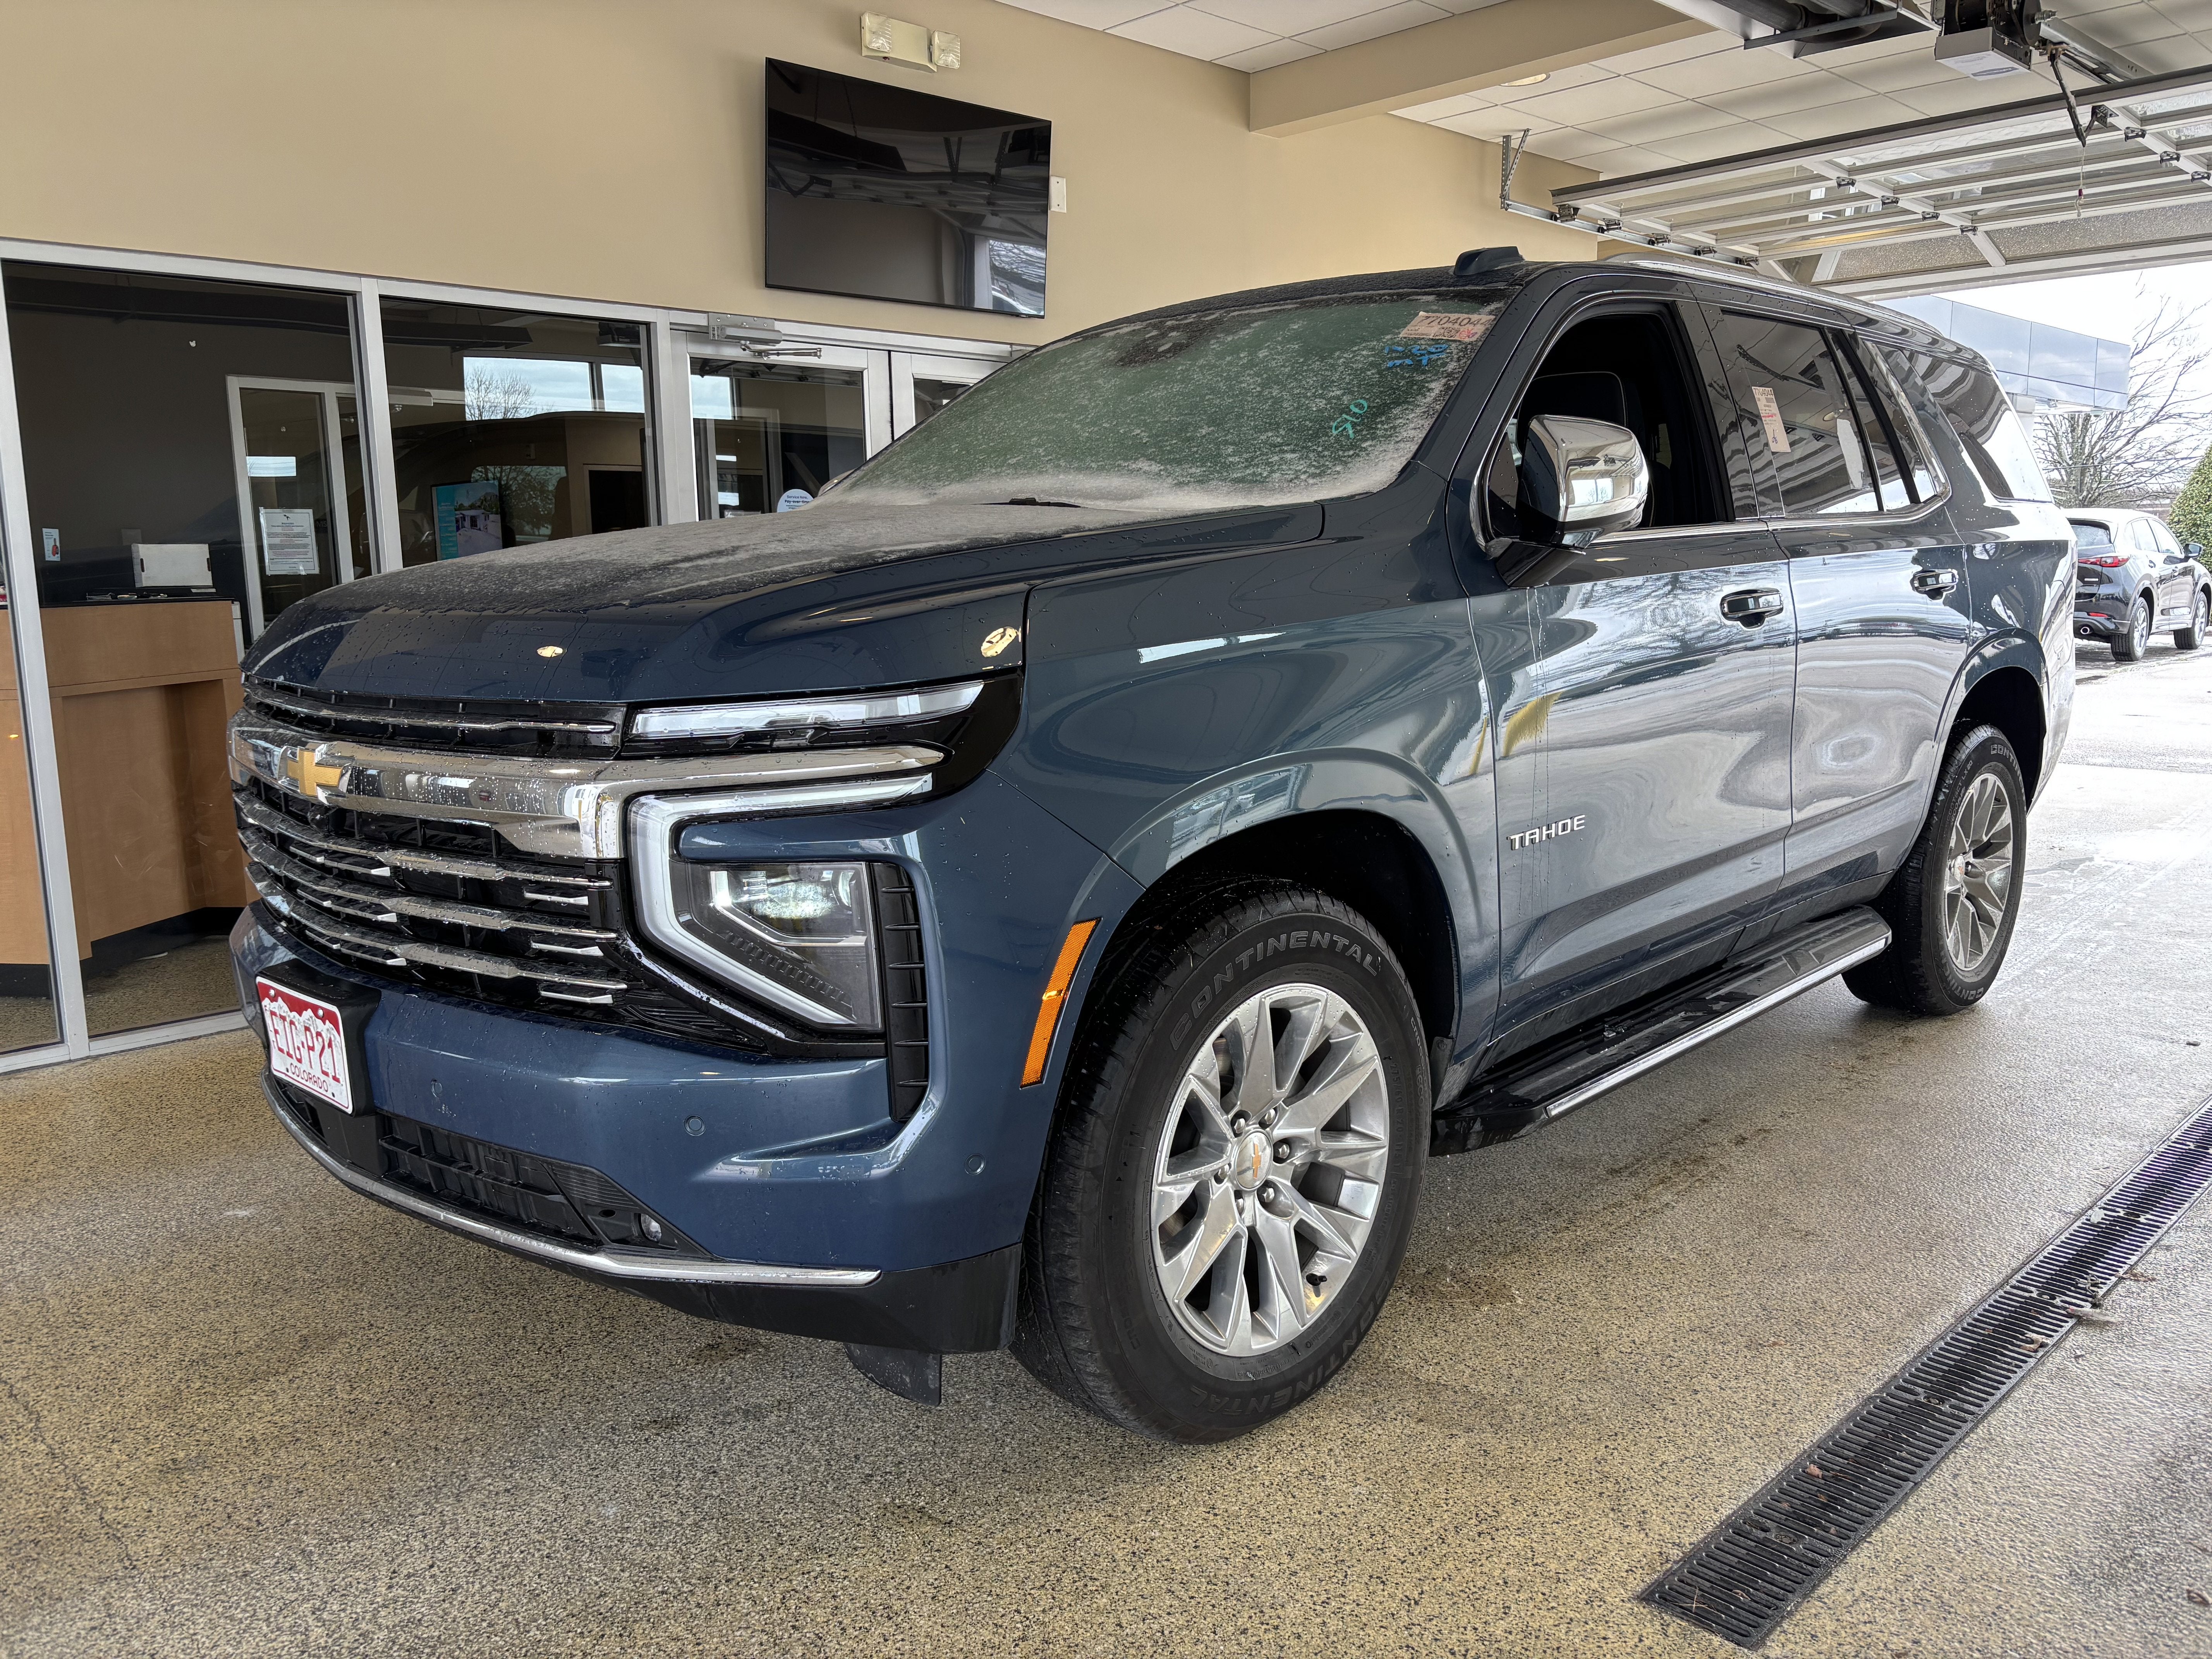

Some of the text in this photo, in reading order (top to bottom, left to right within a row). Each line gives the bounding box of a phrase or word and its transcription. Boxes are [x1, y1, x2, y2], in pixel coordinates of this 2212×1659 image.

[1506, 814, 1586, 850] TAHOE
[1169, 930, 1378, 1051] CONTINENTAL
[290, 1062, 328, 1092] COLORADO
